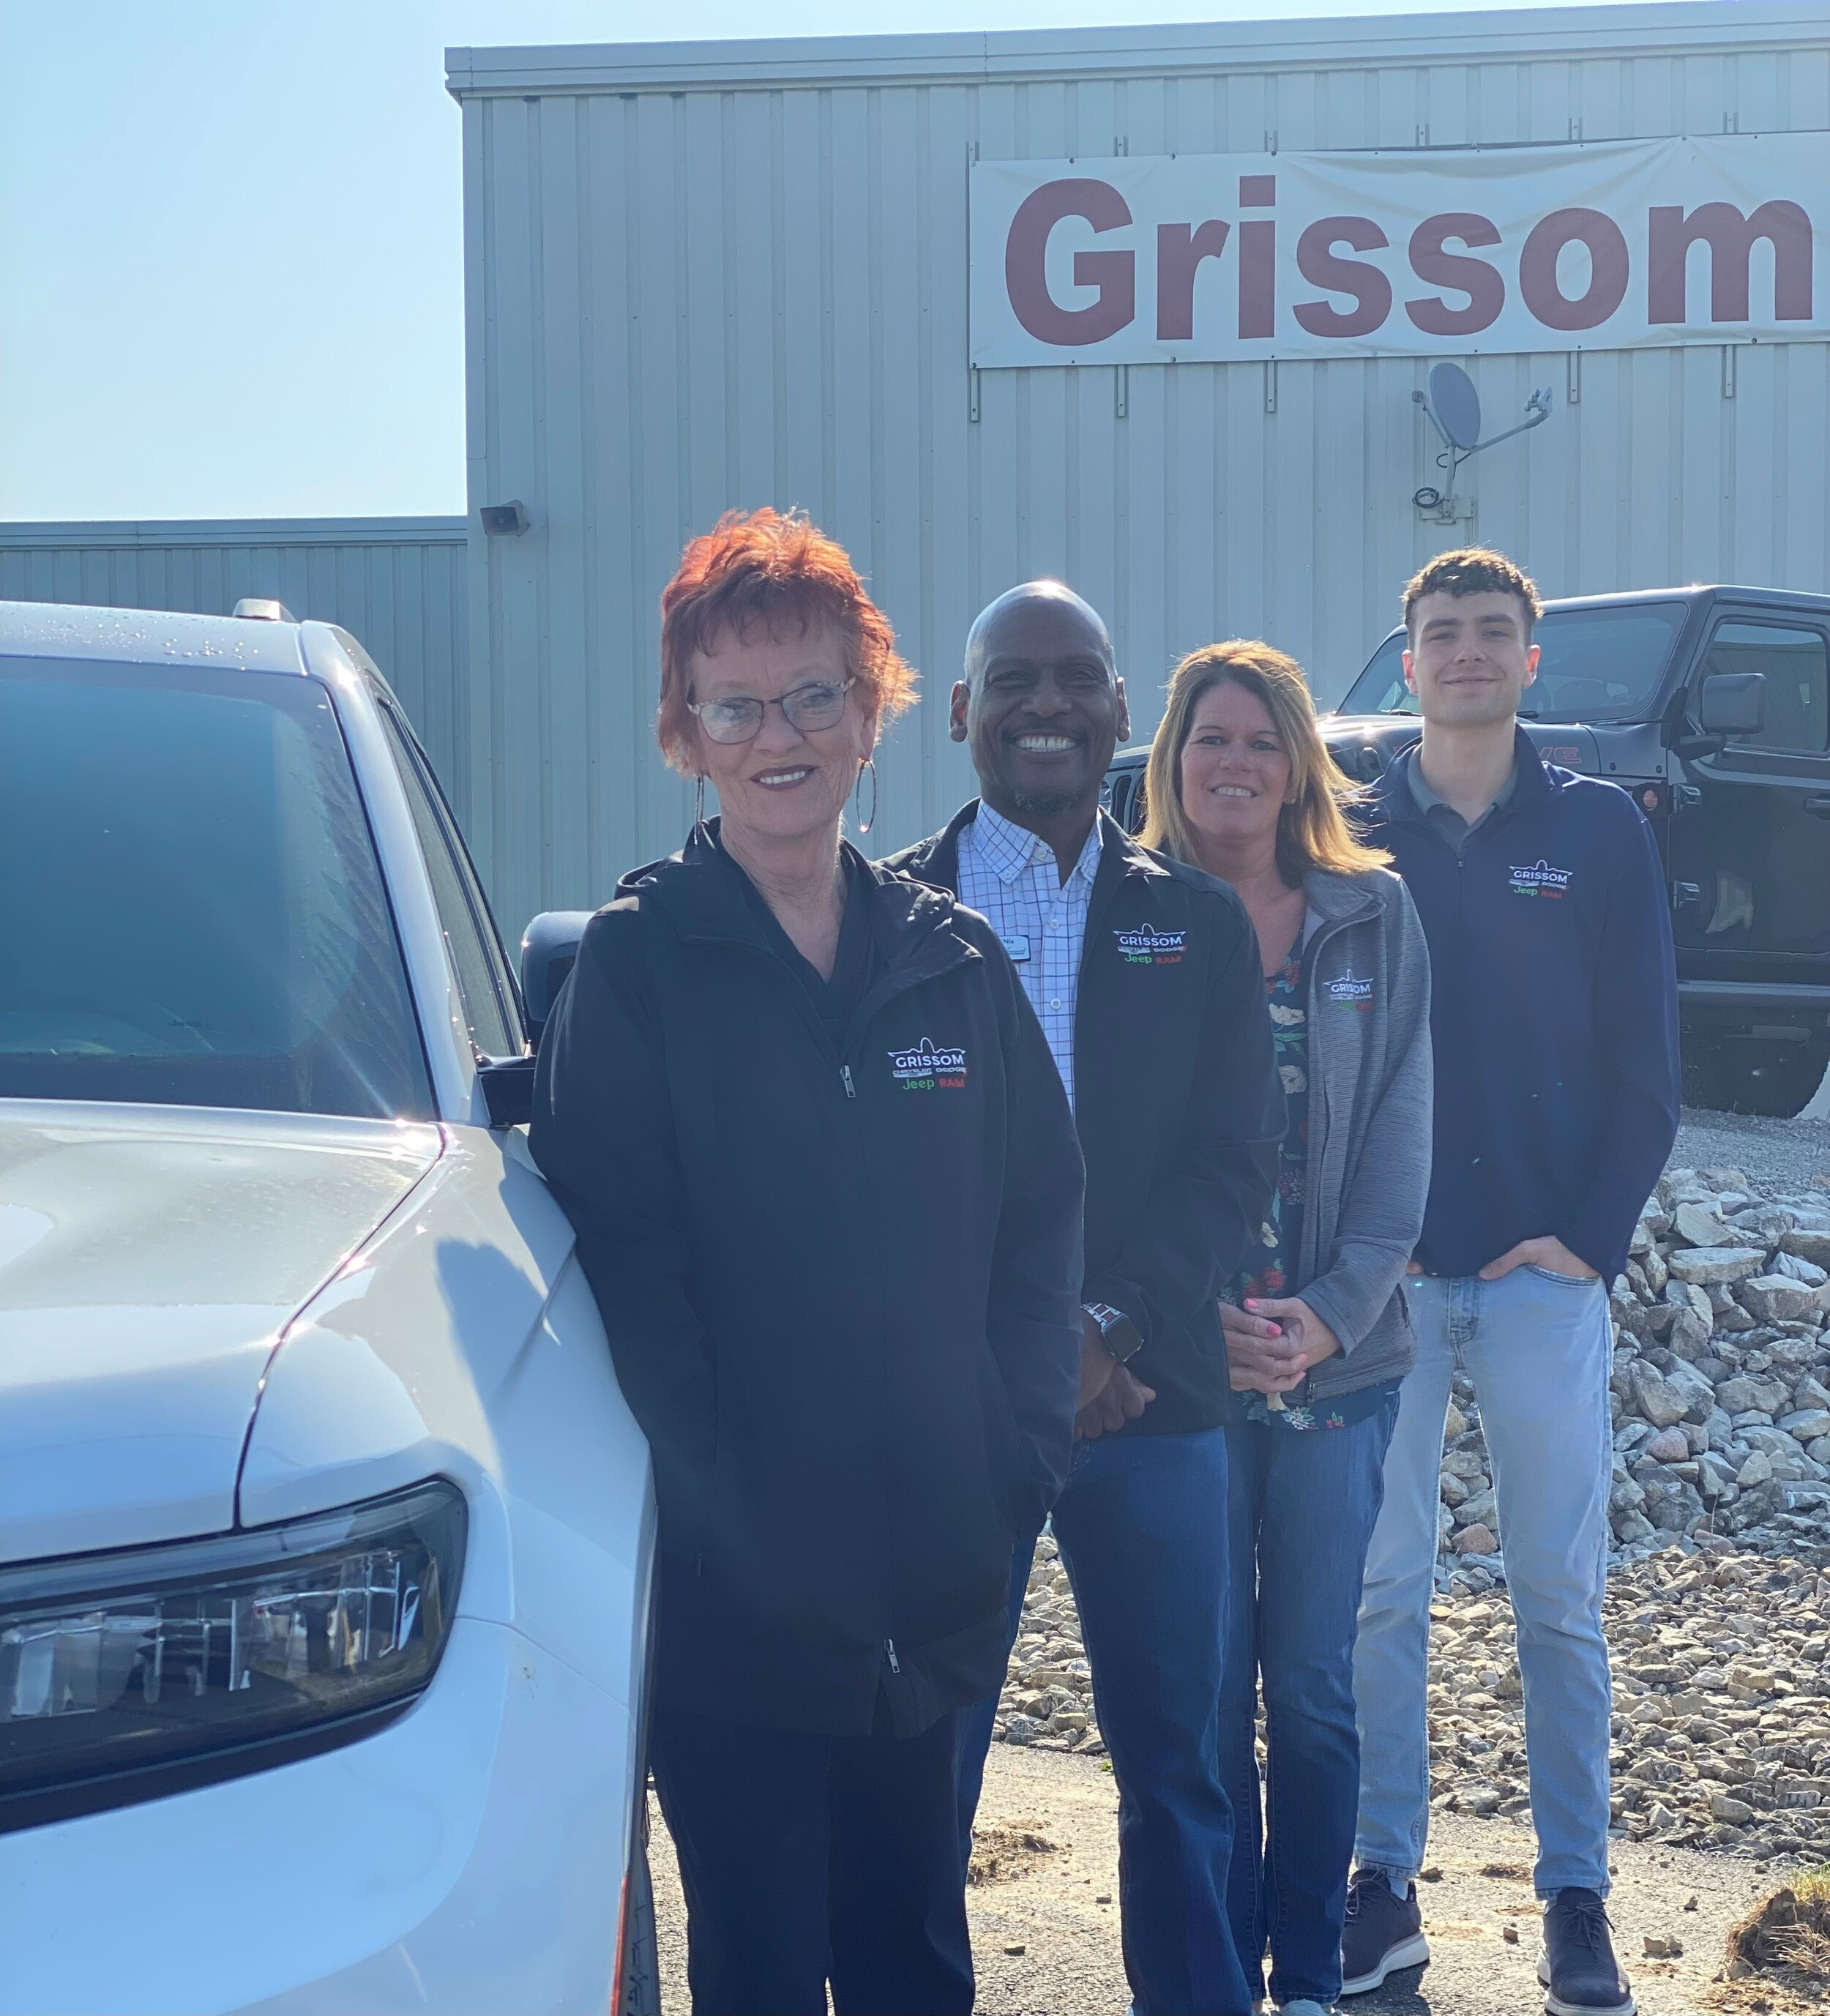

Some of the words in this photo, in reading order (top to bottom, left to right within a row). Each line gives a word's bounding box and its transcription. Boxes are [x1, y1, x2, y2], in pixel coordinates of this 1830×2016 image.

[1005, 174, 1813, 346] Grissom
[1513, 870, 1568, 884] GRISSOM
[1513, 886, 1538, 897] Jeep
[1119, 936, 1182, 947] GRISSOM
[1124, 953, 1152, 964] Jeep
[895, 1054, 964, 1068] GRISSOM
[903, 1078, 935, 1090] Jeep
